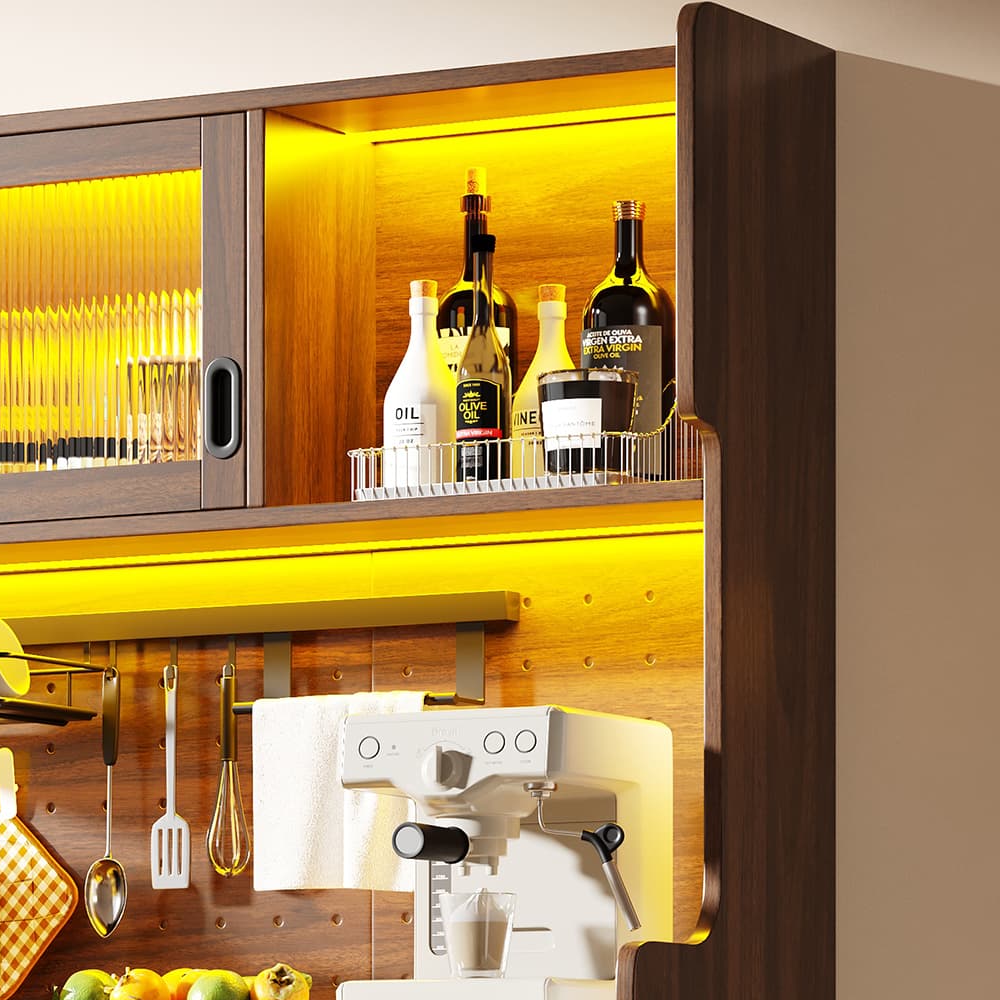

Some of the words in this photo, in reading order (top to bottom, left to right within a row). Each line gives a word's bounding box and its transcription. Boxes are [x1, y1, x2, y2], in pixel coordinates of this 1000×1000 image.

[609, 335, 642, 344] EXTRA
[606, 343, 642, 352] VIRGIN
[459, 402, 487, 411] OLIVE
[395, 407, 419, 420] OIL
[463, 411, 480, 420] OIL
